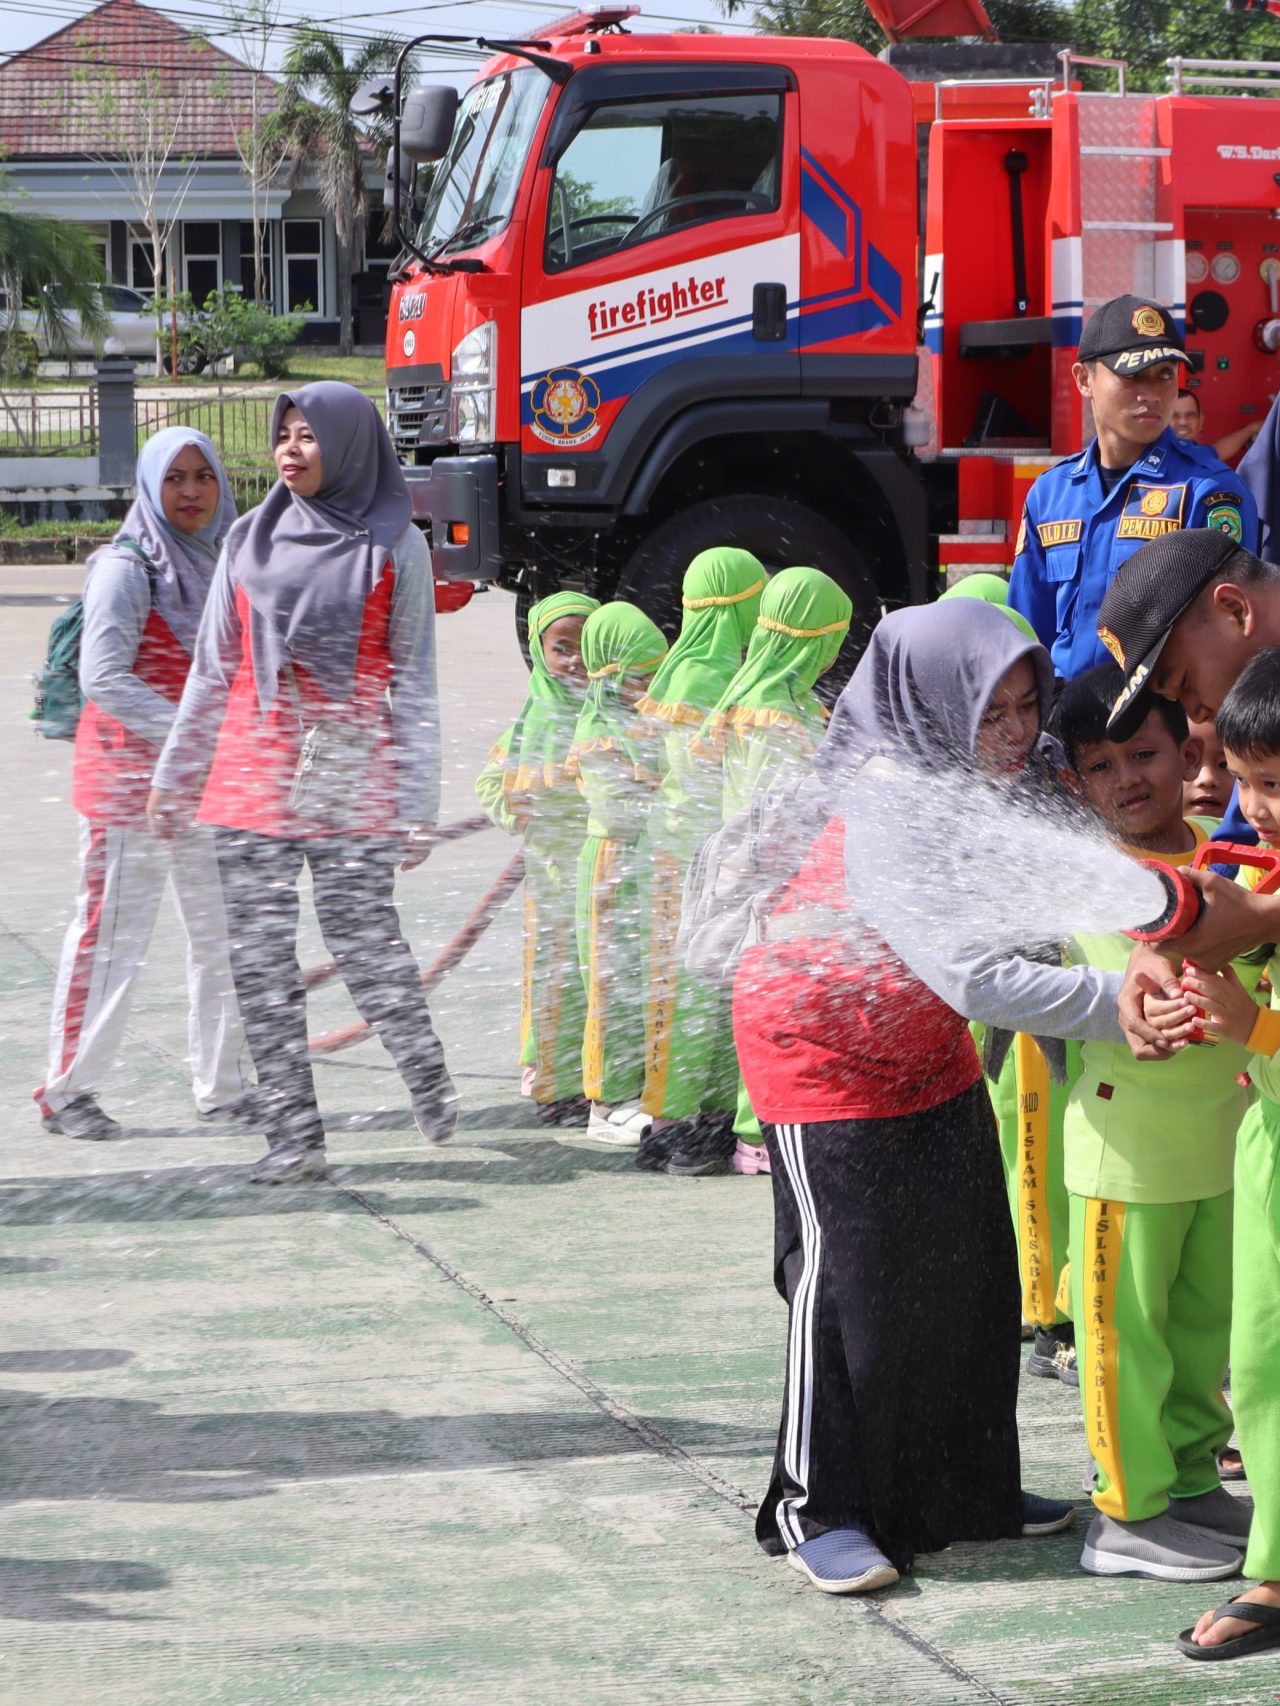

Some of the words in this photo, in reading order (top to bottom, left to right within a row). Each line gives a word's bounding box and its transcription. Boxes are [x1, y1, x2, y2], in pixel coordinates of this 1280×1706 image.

[588, 277, 726, 335] firefighter
[1023, 1121, 1038, 1189] ISLAM
[1092, 1203, 1109, 1283] ISLAM
[1093, 1296, 1108, 1448] SALSABILLA
